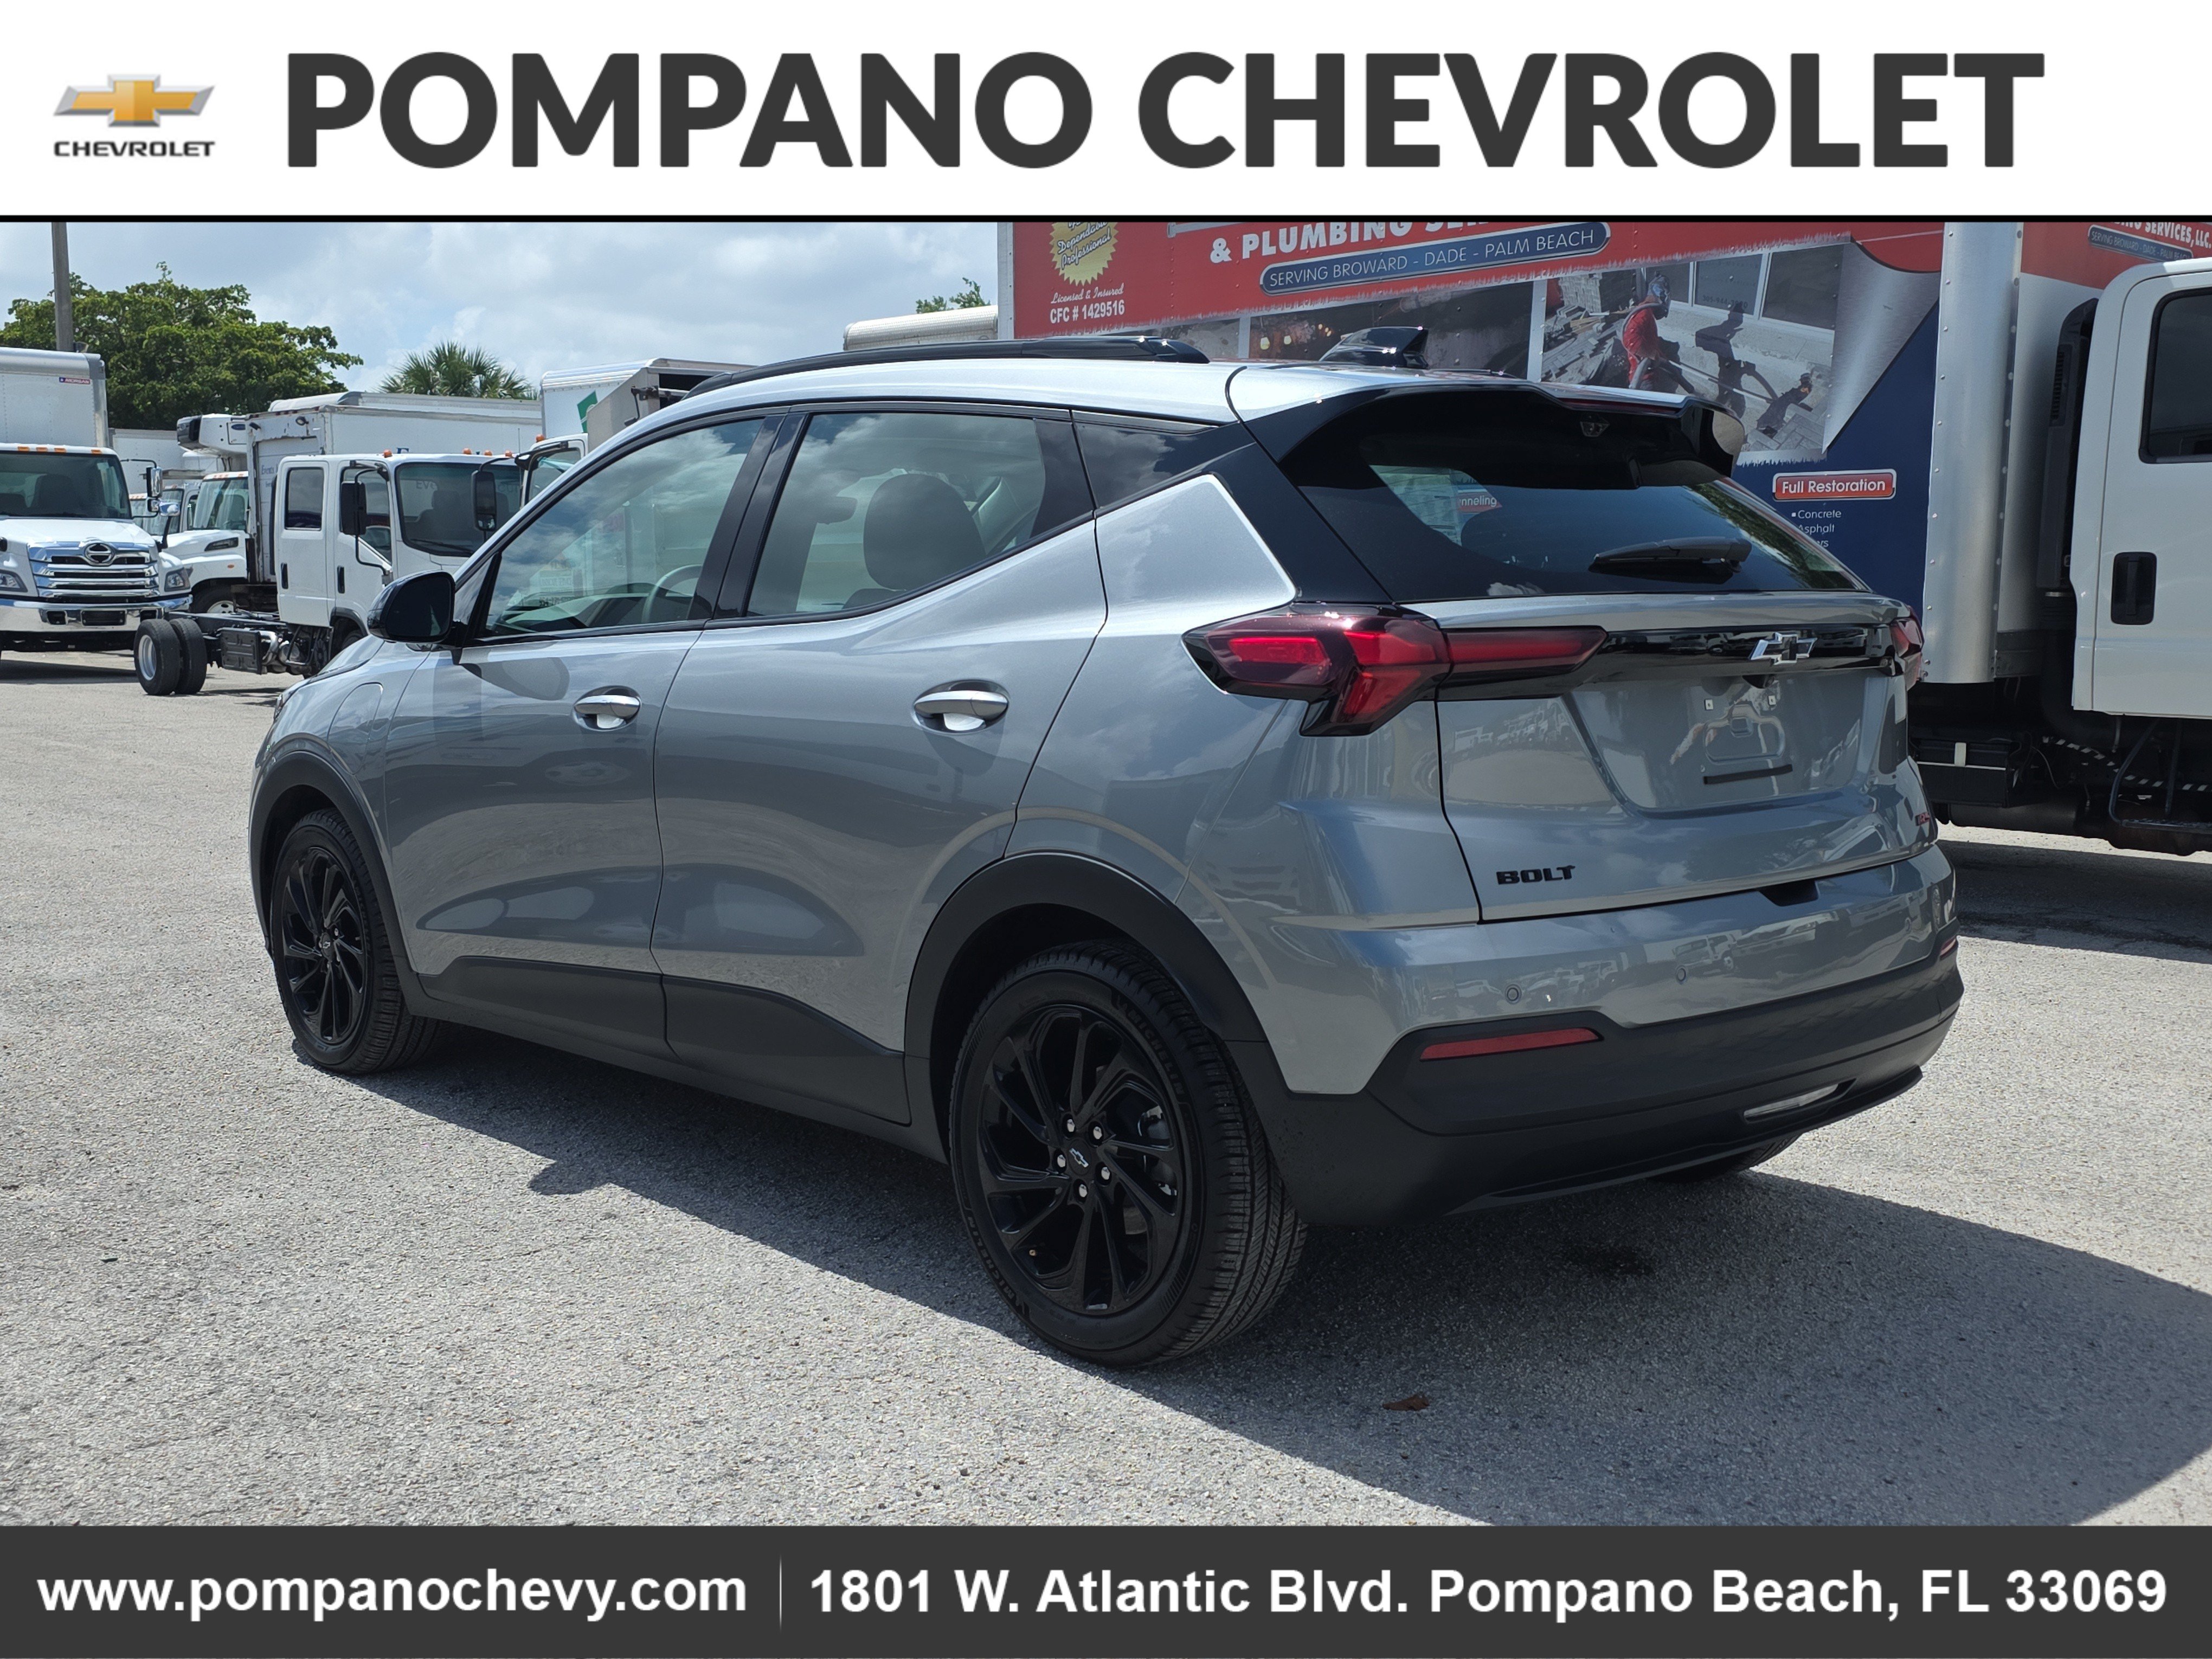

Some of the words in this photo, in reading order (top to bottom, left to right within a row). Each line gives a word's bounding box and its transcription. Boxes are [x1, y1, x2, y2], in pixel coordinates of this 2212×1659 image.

[1062, 227, 1111, 269] Professional
[1210, 237, 1232, 263] &
[1243, 222, 1413, 259] PLUMBING
[2091, 231, 2113, 245] SERVING
[2174, 252, 2191, 260] BEAC
[2196, 229, 2212, 249] LLC.
[1269, 266, 1328, 287] SERVING
[1333, 255, 1408, 278] BROWARD
[1425, 247, 1467, 266] DADE
[1485, 238, 1529, 259] PALM
[1536, 229, 1594, 252] BEACH
[1051, 288, 1084, 304] Licensed
[1085, 290, 1091, 299] &
[1092, 282, 1124, 299] Insured
[1050, 307, 1070, 324] CFC
[1072, 305, 1079, 321] #
[1082, 299, 1125, 319] 1429516
[1782, 480, 1804, 494] Full
[1808, 478, 1886, 493] Restoration
[1459, 494, 1497, 507] nneling
[1798, 510, 1842, 519] Concrete
[1798, 523, 1835, 535] Asphalt
[1496, 865, 1576, 885] BOLT
[1128, 1009, 1186, 1095] MICHELIN
[968, 1216, 1015, 1299] MICHELIN
